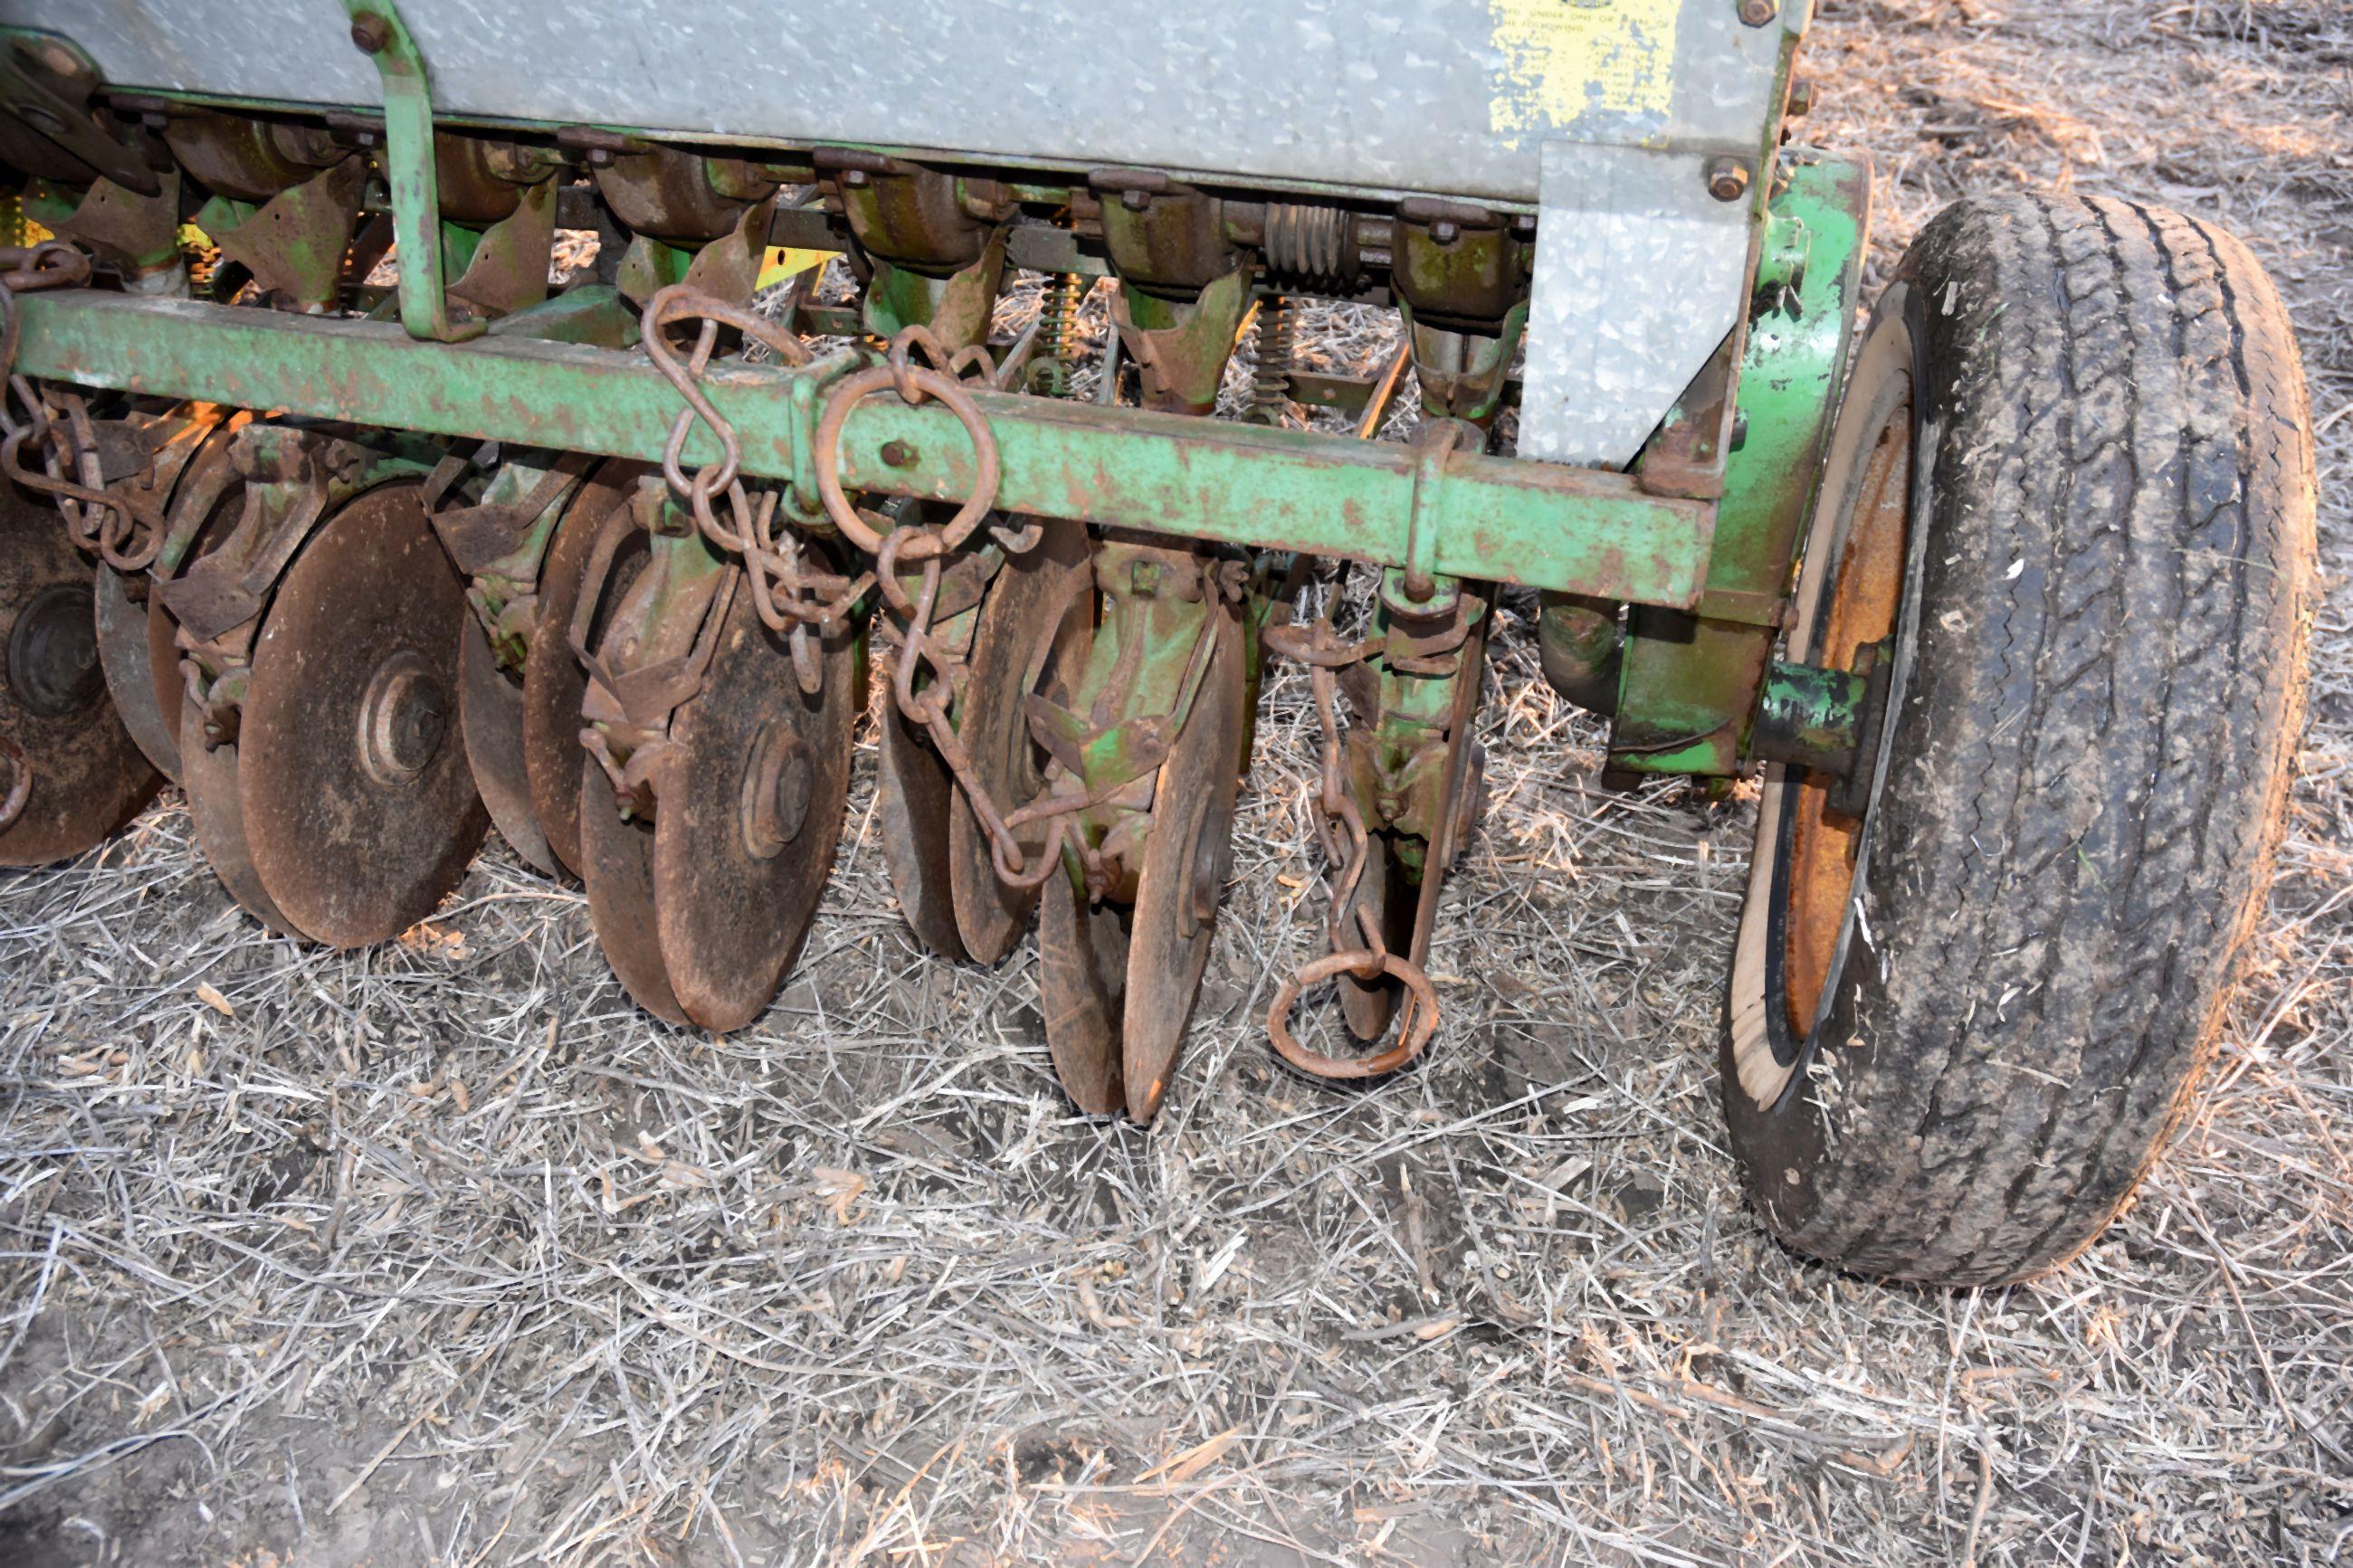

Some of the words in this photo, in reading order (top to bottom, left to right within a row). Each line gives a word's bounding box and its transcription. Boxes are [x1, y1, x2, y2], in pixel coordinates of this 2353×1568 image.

[1529, 10, 1564, 18] UNDER
[1570, 13, 1591, 21] ONE
[1598, 15, 1615, 24] OR
